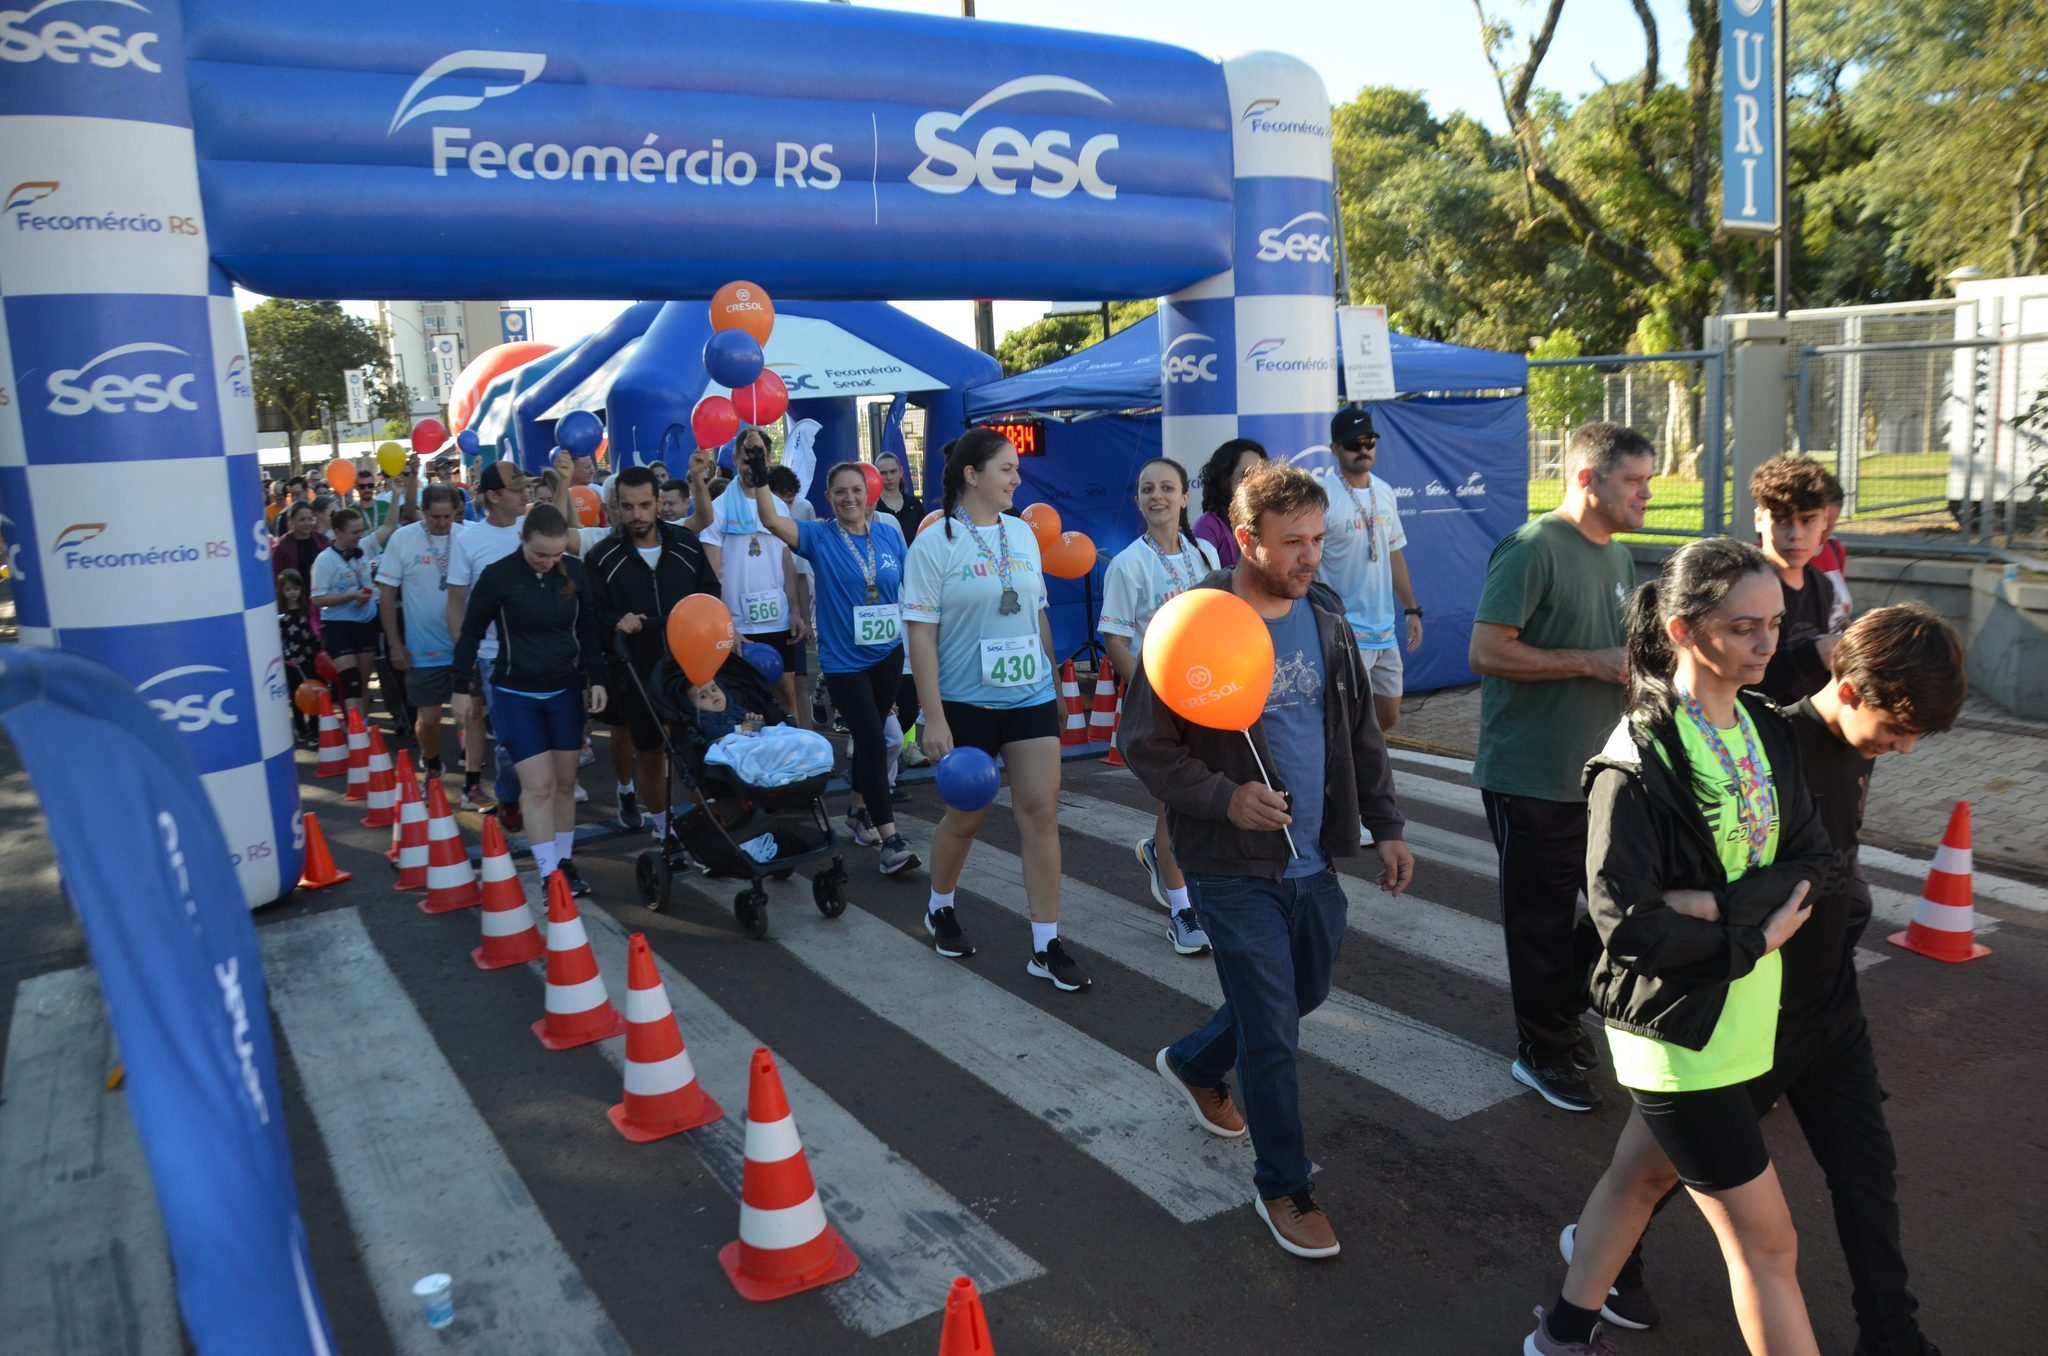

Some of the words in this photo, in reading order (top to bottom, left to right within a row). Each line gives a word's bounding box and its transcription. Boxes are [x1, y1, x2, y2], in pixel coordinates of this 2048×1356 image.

[432, 126, 757, 187] Fecomércio
[774, 141, 842, 190] RS
[908, 110, 1119, 200] Sesc
[17, 211, 162, 234] Fecomércio
[168, 215, 199, 236] RS
[726, 302, 764, 314] CRESOL
[825, 364, 902, 379] Fecomércio
[833, 377, 876, 389] Senac
[47, 367, 198, 416] Sesc
[66, 547, 200, 570] Fecomércio
[205, 541, 232, 560] RS
[749, 601, 779, 621] 566
[862, 618, 896, 641] 520
[991, 653, 1036, 683] 430
[247, 844, 272, 863] RS
